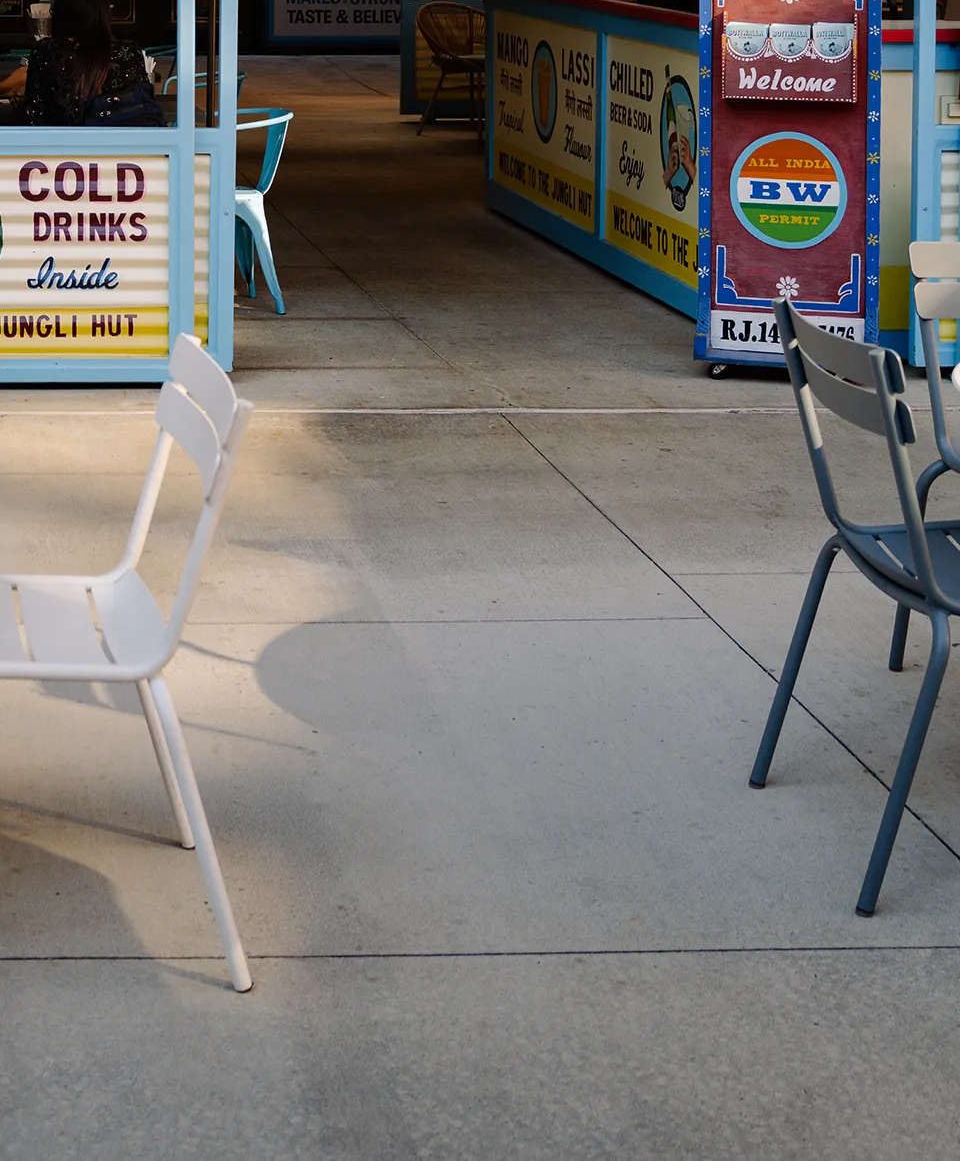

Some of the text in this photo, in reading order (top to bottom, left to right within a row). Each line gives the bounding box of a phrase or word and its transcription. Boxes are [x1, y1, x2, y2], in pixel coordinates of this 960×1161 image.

[286, 9, 402, 24] TASTE & BELIEV
[497, 30, 529, 69] MANGO
[562, 48, 594, 88] LASSI
[610, 60, 654, 102] CHILLED
[739, 67, 837, 93] Welcome
[610, 101, 627, 127] BEER
[633, 109, 653, 135] SODA
[619, 140, 645, 190] Enjoy
[747, 157, 831, 169] ALL INDIA
[18, 161, 146, 203] COLD
[499, 150, 592, 218] WELCOME TO THE JUNGLI HUT
[749, 180, 832, 203] BW
[32, 212, 148, 242] DRINKS
[614, 204, 653, 250] WELCOME
[656, 225, 668, 256] TO
[672, 232, 689, 268] THE
[759, 213, 820, 226] PERMIT
[27, 256, 120, 290] Inside
[92, 314, 137, 338] HUT
